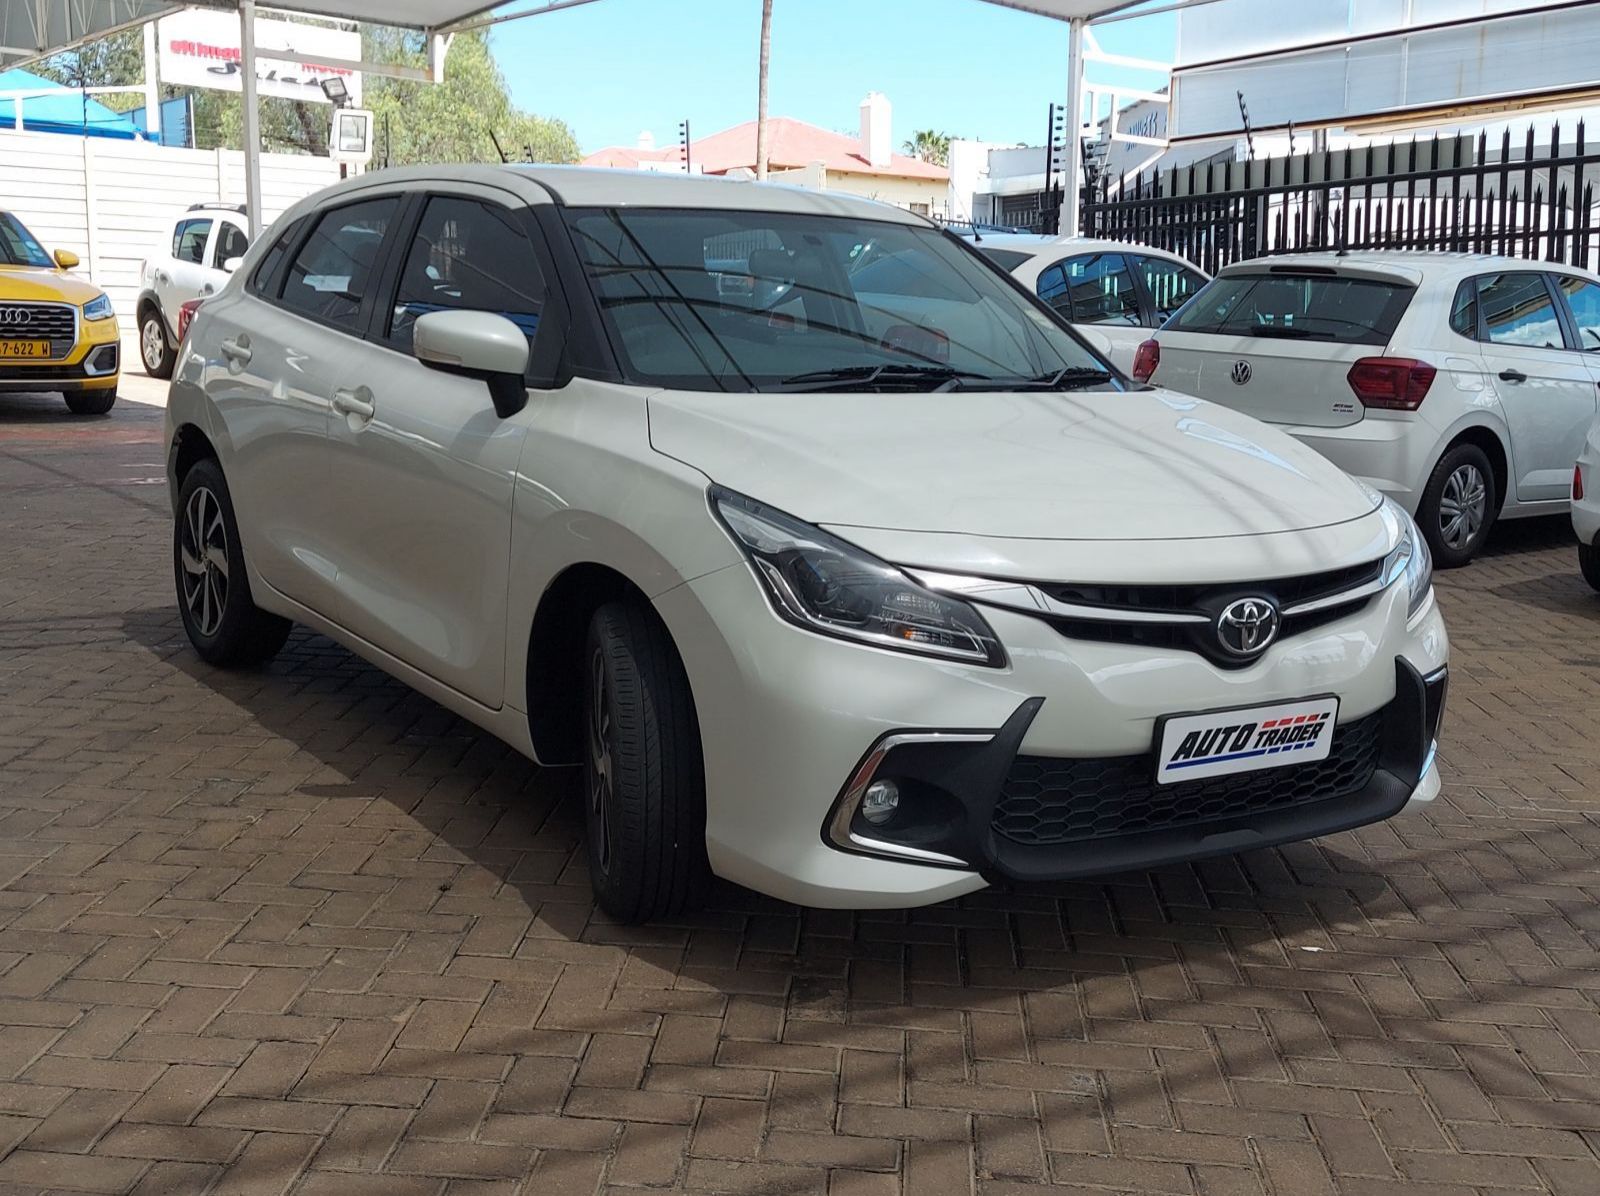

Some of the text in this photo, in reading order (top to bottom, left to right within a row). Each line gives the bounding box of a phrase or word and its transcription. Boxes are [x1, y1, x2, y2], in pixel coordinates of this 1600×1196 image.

[0, 342, 34, 355] 7-622
[1170, 722, 1326, 761] AUTO TRADER
